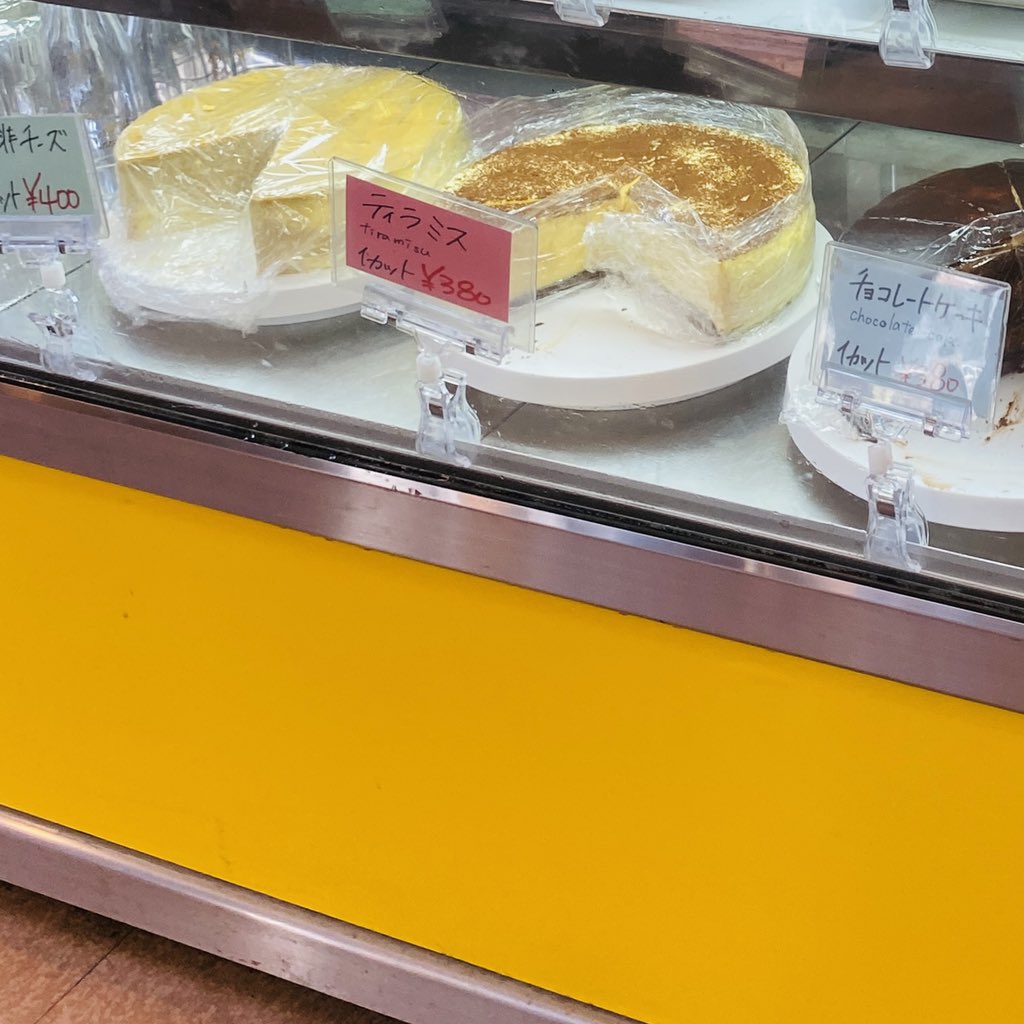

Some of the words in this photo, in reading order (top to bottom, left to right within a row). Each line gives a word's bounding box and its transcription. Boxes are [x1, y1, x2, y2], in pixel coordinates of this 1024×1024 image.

[22, 172, 80, 215] ¥400
[360, 222, 431, 258] tiramisu
[362, 193, 468, 252] ティラミス
[358, 247, 416, 280] 1カット
[421, 263, 492, 306] ¥380
[850, 268, 984, 333] チョコレートケーキ
[837, 340, 891, 375] 1カット
